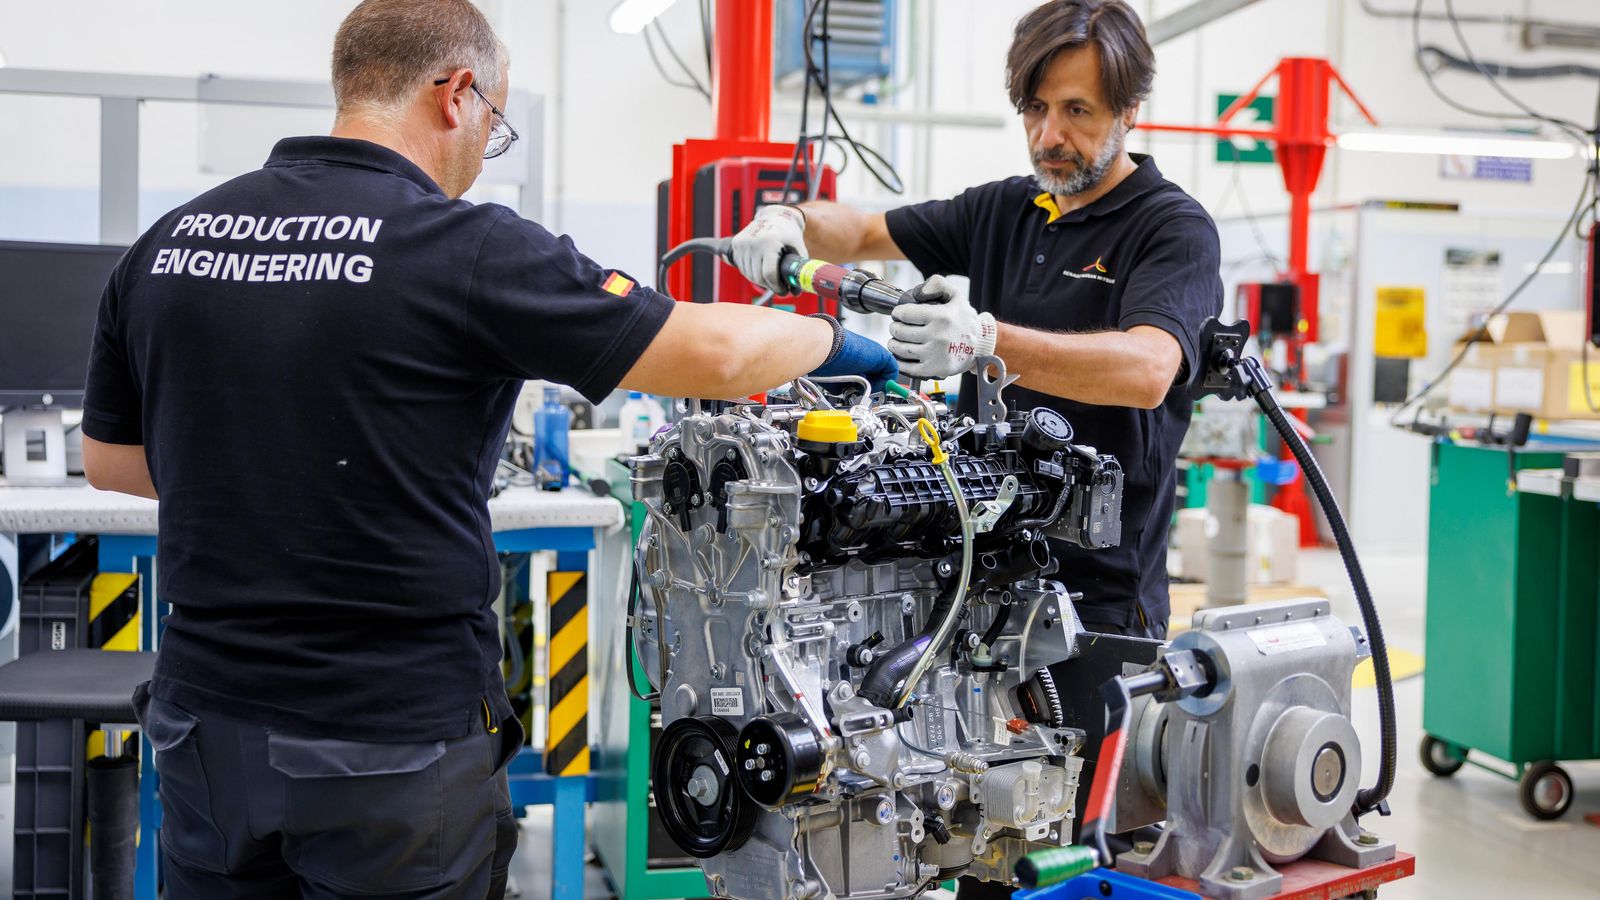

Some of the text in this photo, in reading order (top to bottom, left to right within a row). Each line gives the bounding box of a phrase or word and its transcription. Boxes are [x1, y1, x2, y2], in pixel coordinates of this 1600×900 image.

[171, 213, 383, 243] PRODUCTION
[150, 248, 374, 283] ENGINEERING
[948, 342, 975, 356] HyFlex
